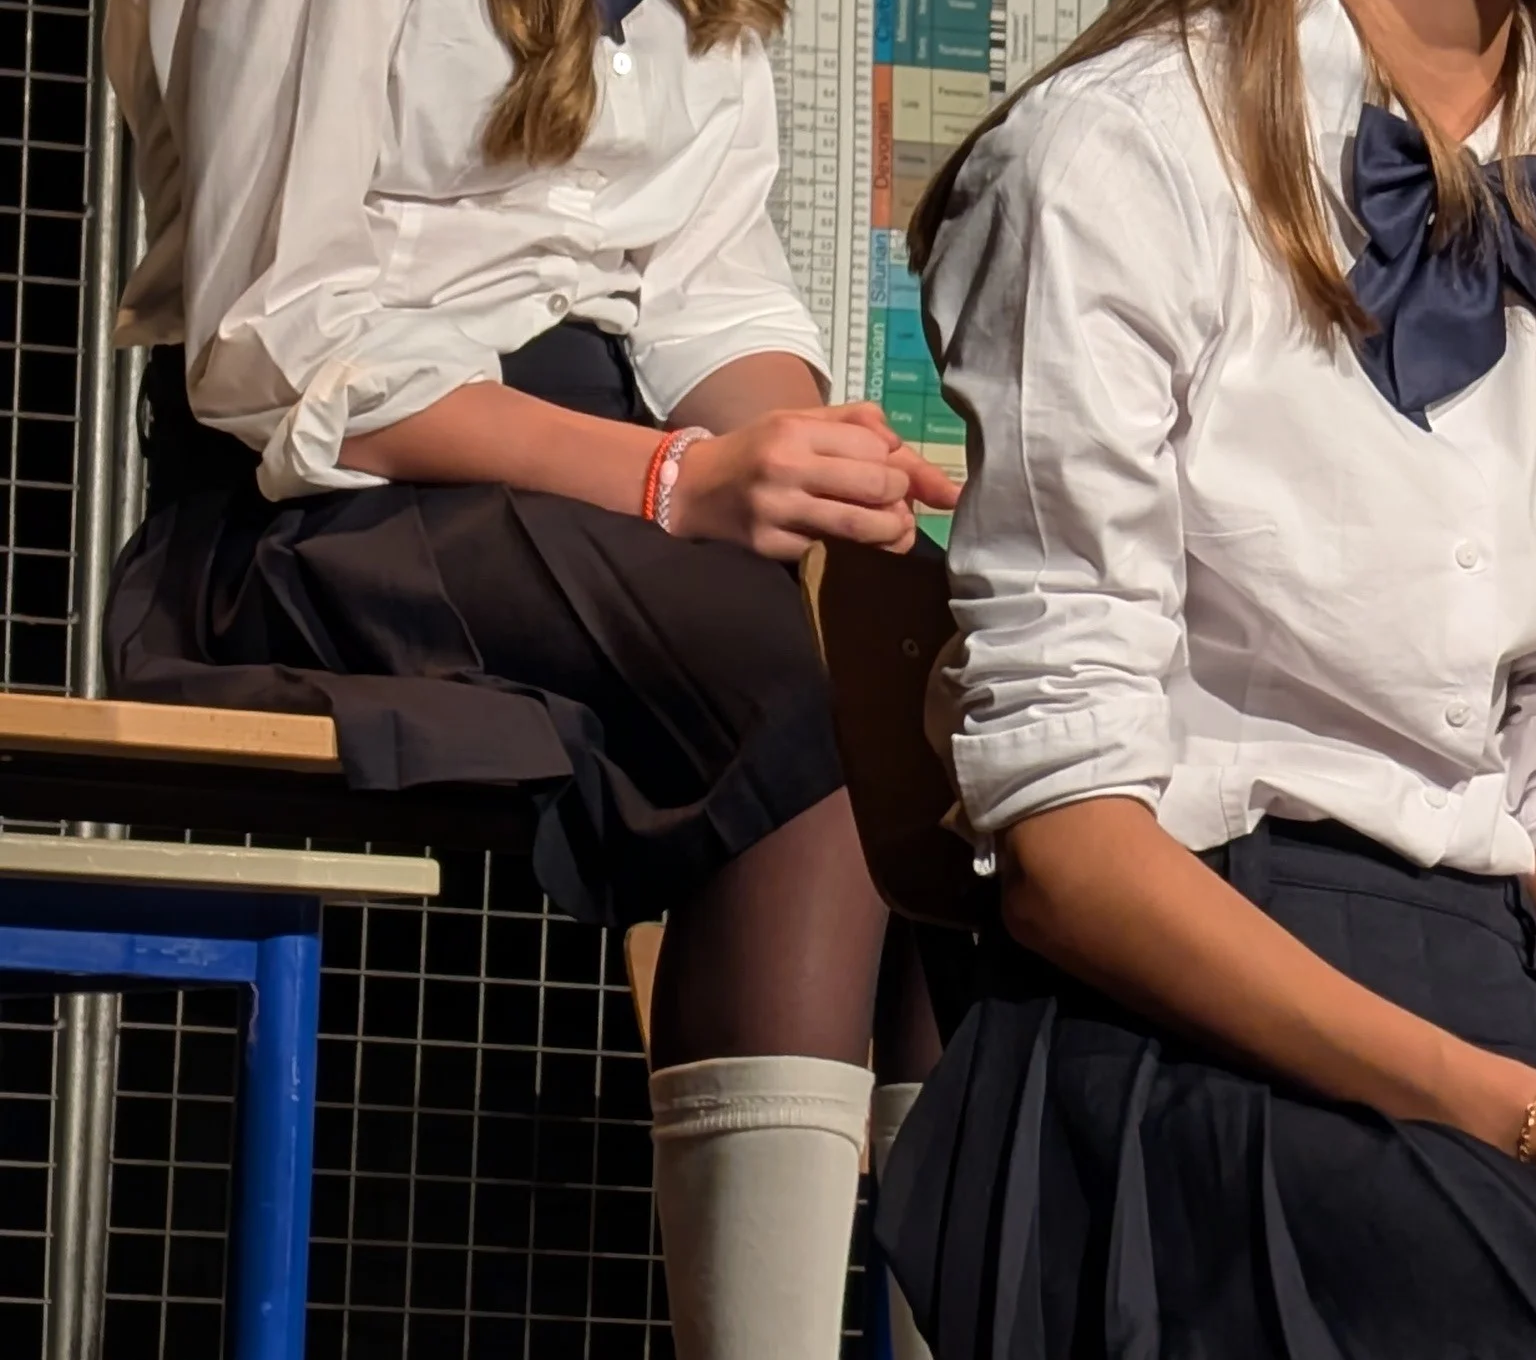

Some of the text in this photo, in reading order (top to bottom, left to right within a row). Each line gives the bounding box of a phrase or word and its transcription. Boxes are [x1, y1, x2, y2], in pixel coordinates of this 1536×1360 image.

[873, 101, 890, 190] Devonian
[871, 233, 887, 303] Silurian
[868, 322, 885, 401] dovician
